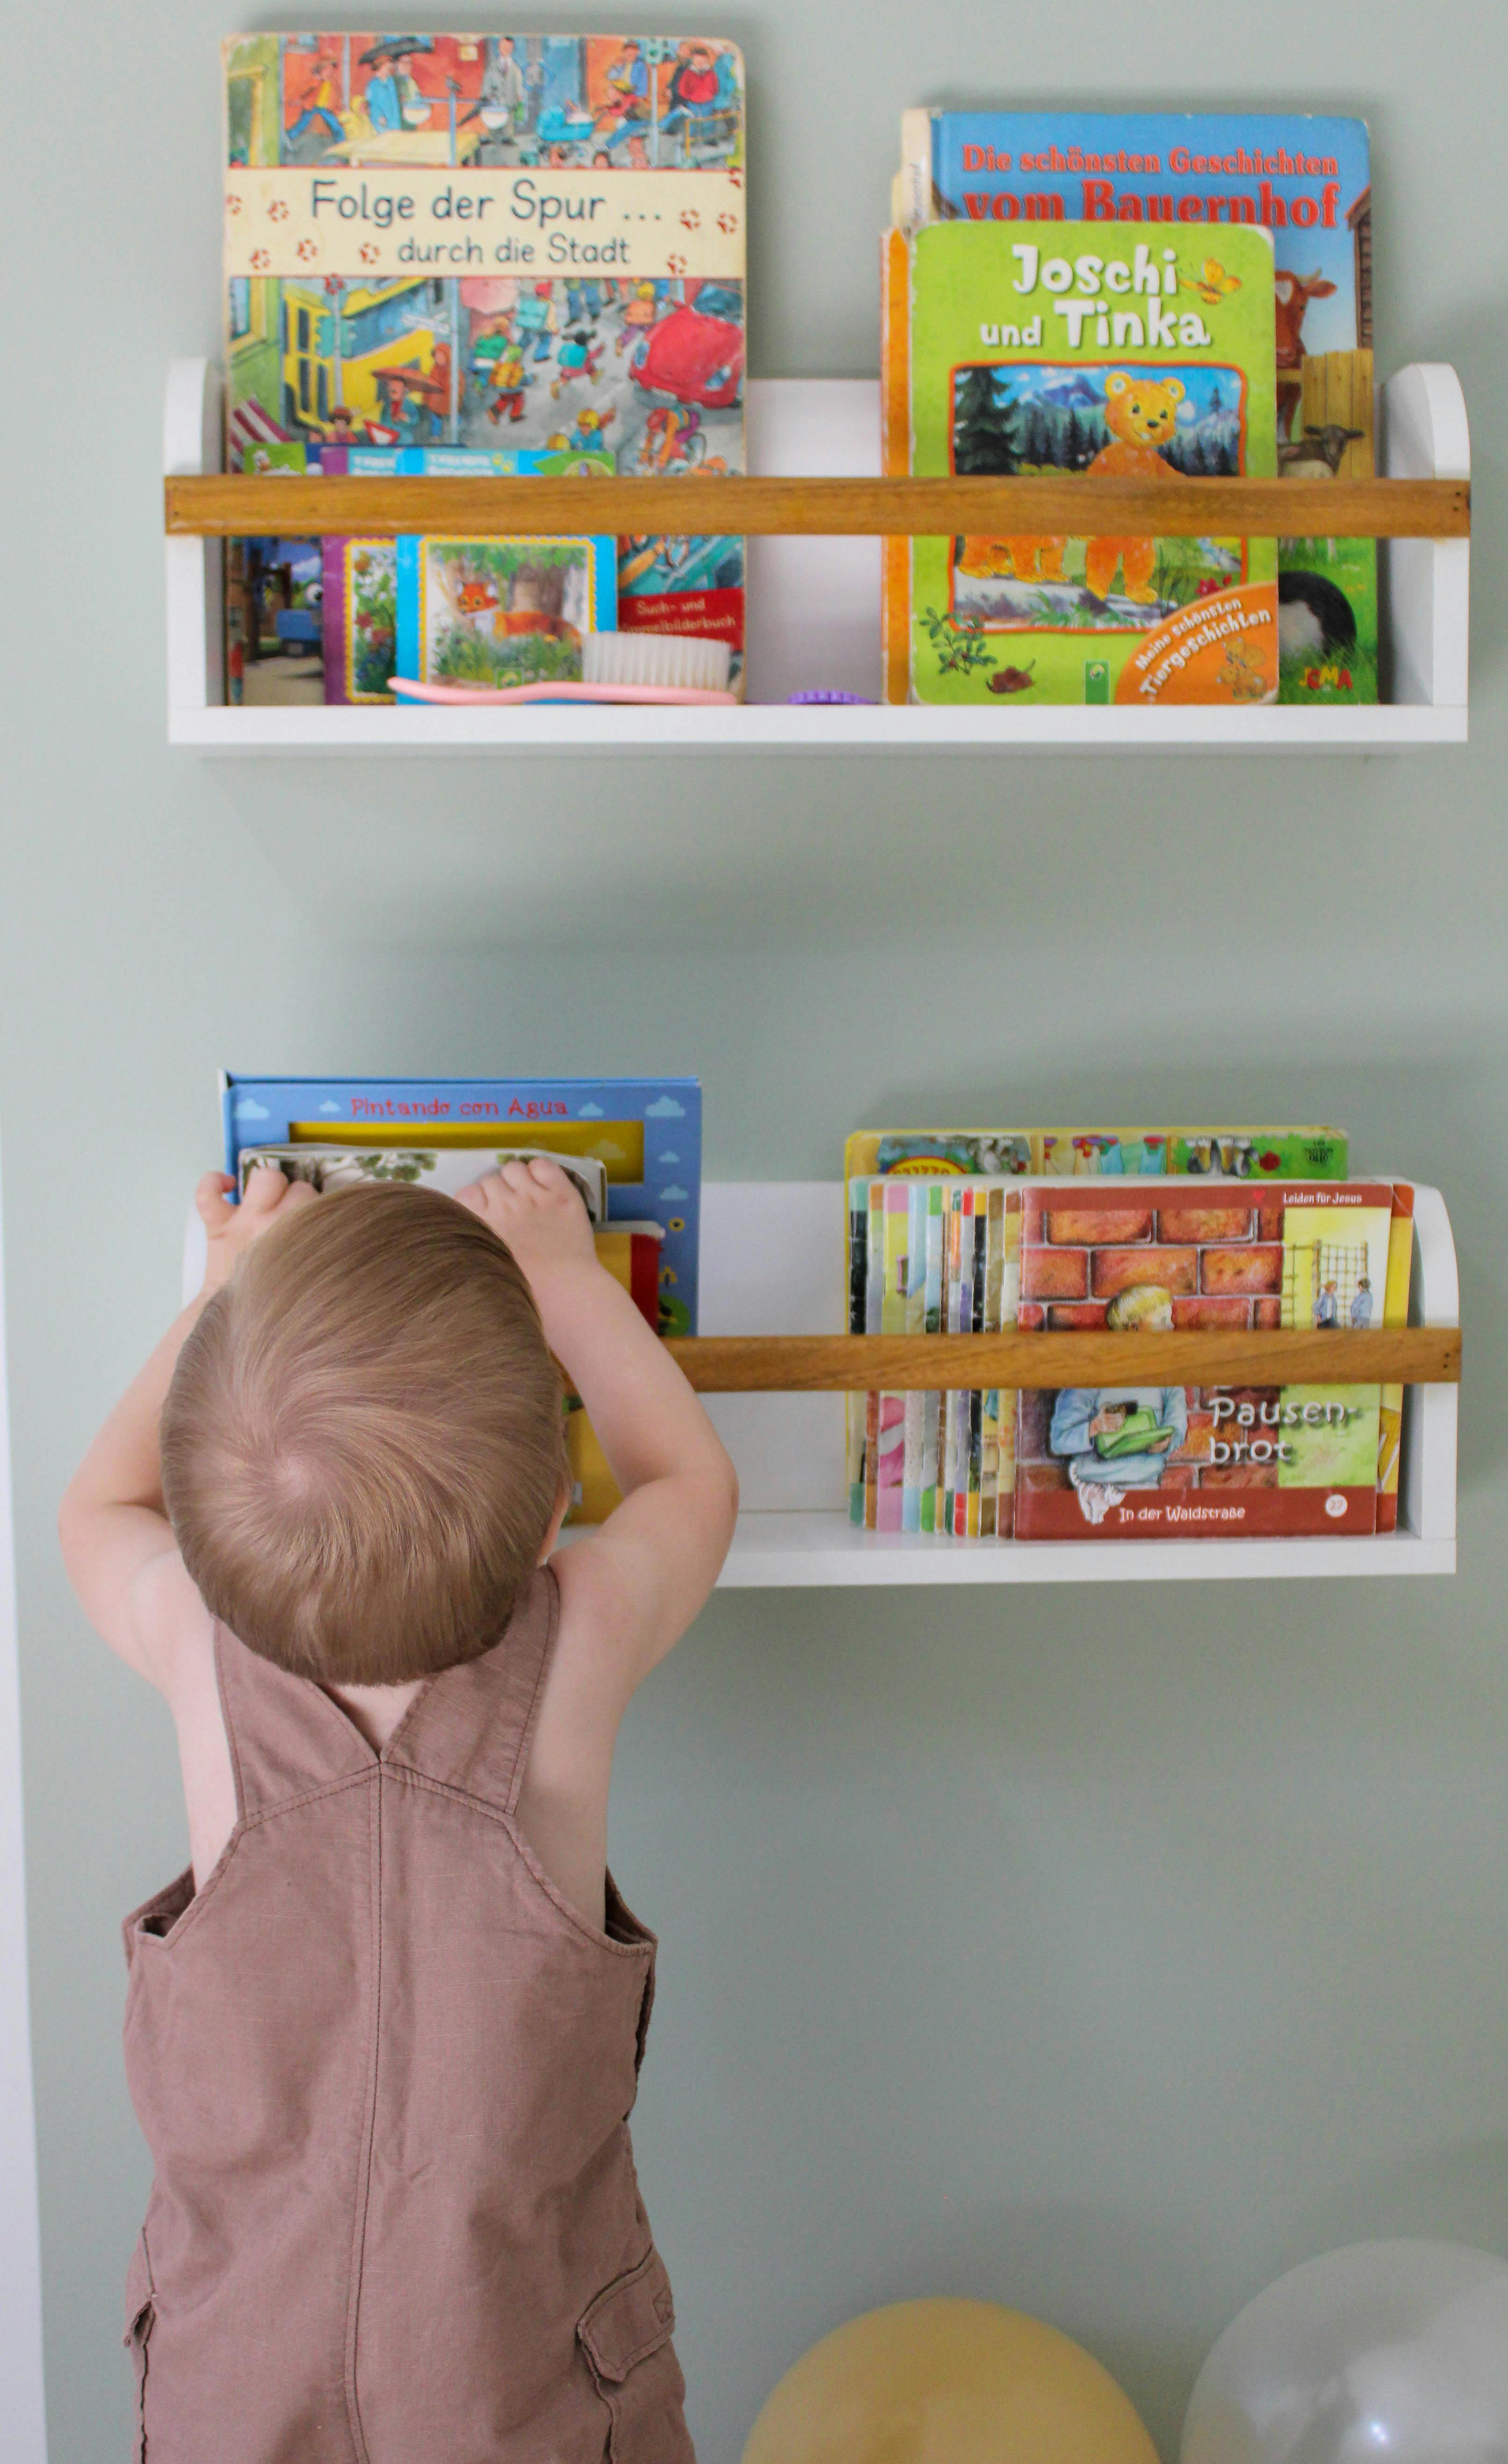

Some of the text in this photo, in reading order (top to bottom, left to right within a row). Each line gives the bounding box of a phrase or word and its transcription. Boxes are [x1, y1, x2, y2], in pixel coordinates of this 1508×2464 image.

[962, 144, 1340, 176] Die schönsten Geschichten
[311, 179, 416, 228] Folge
[431, 185, 494, 219] der
[510, 177, 606, 228] Spur
[963, 192, 1066, 221] vom
[1081, 178, 1342, 228] Bauernhof
[398, 232, 631, 264] durch die Stadt
[1012, 243, 1178, 295] Joschi
[980, 297, 1212, 348] und Tinka
[635, 598, 706, 615] Such- und
[1134, 597, 1243, 671] Meine schönsten
[1139, 608, 1272, 695] Tiergeschichten
[351, 1097, 569, 1119] Pintando con Agua
[1283, 1192, 1363, 1205] Leiden für Jesus
[1208, 1396, 1358, 1429] Pausen-
[1209, 1436, 1292, 1464] brot
[1119, 1505, 1246, 1523] In der Waldstraße
